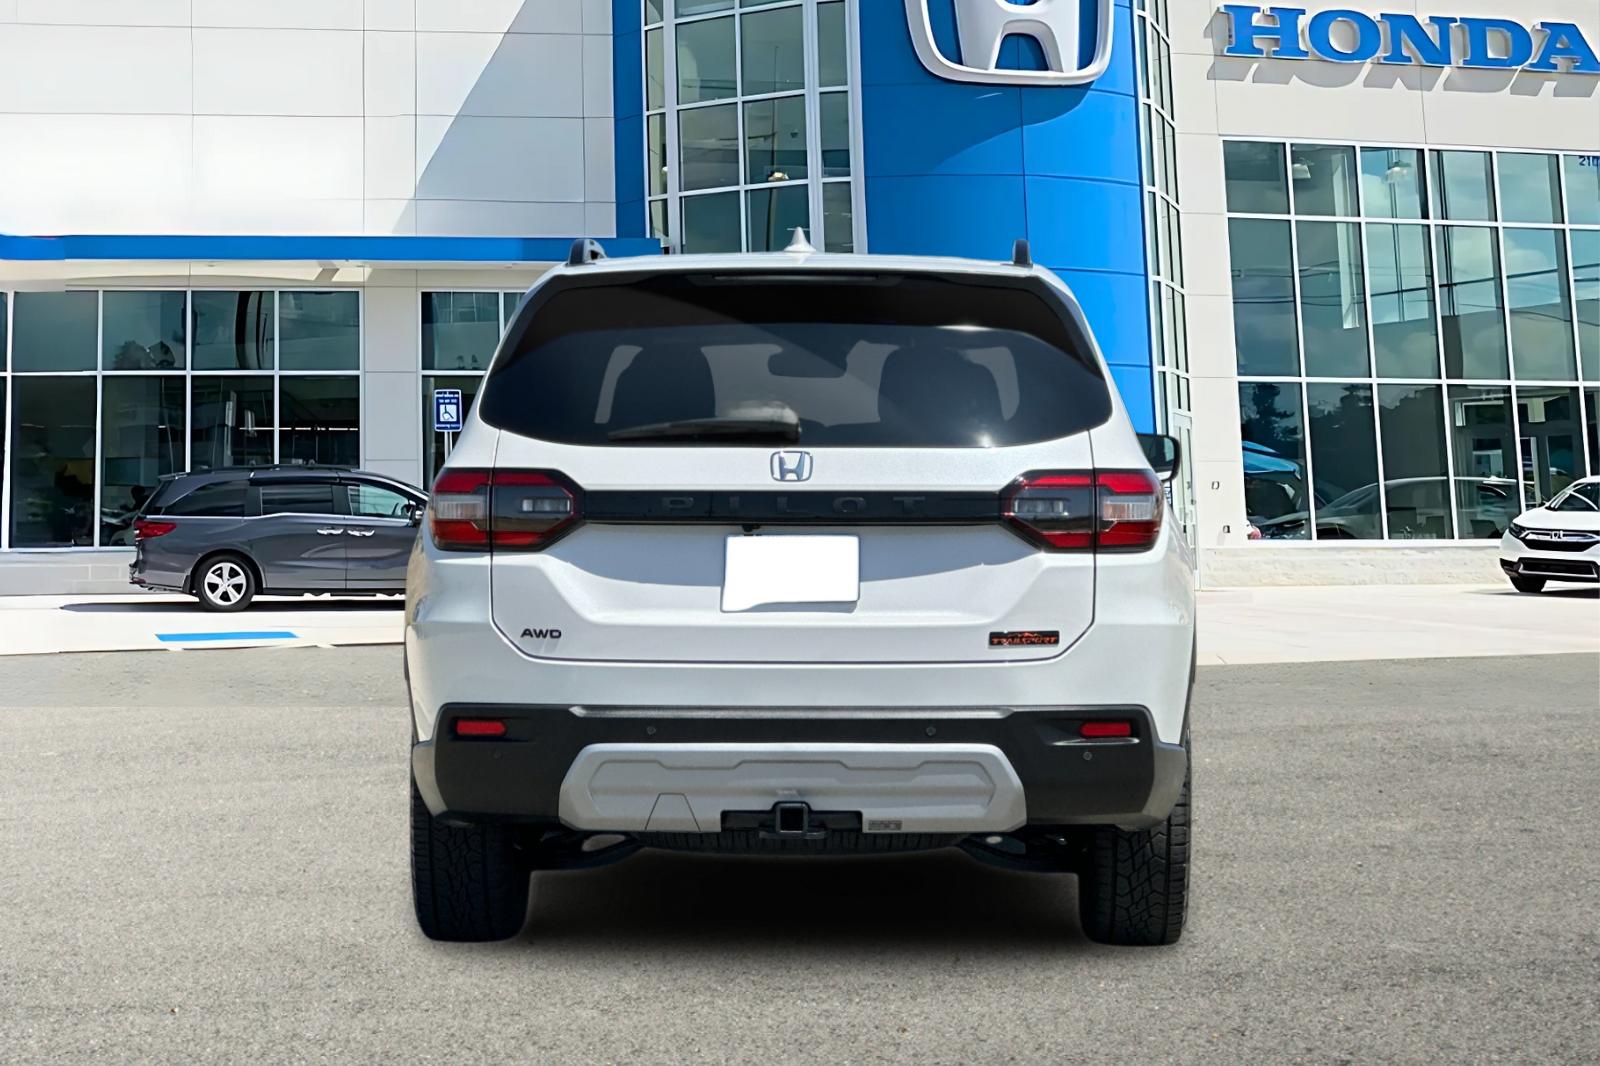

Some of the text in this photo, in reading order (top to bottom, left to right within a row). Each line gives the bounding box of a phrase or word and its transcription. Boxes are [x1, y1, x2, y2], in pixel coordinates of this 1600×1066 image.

[1224, 5, 1600, 73] HONDA
[661, 495, 926, 513] PILOT
[520, 628, 562, 639] AWD
